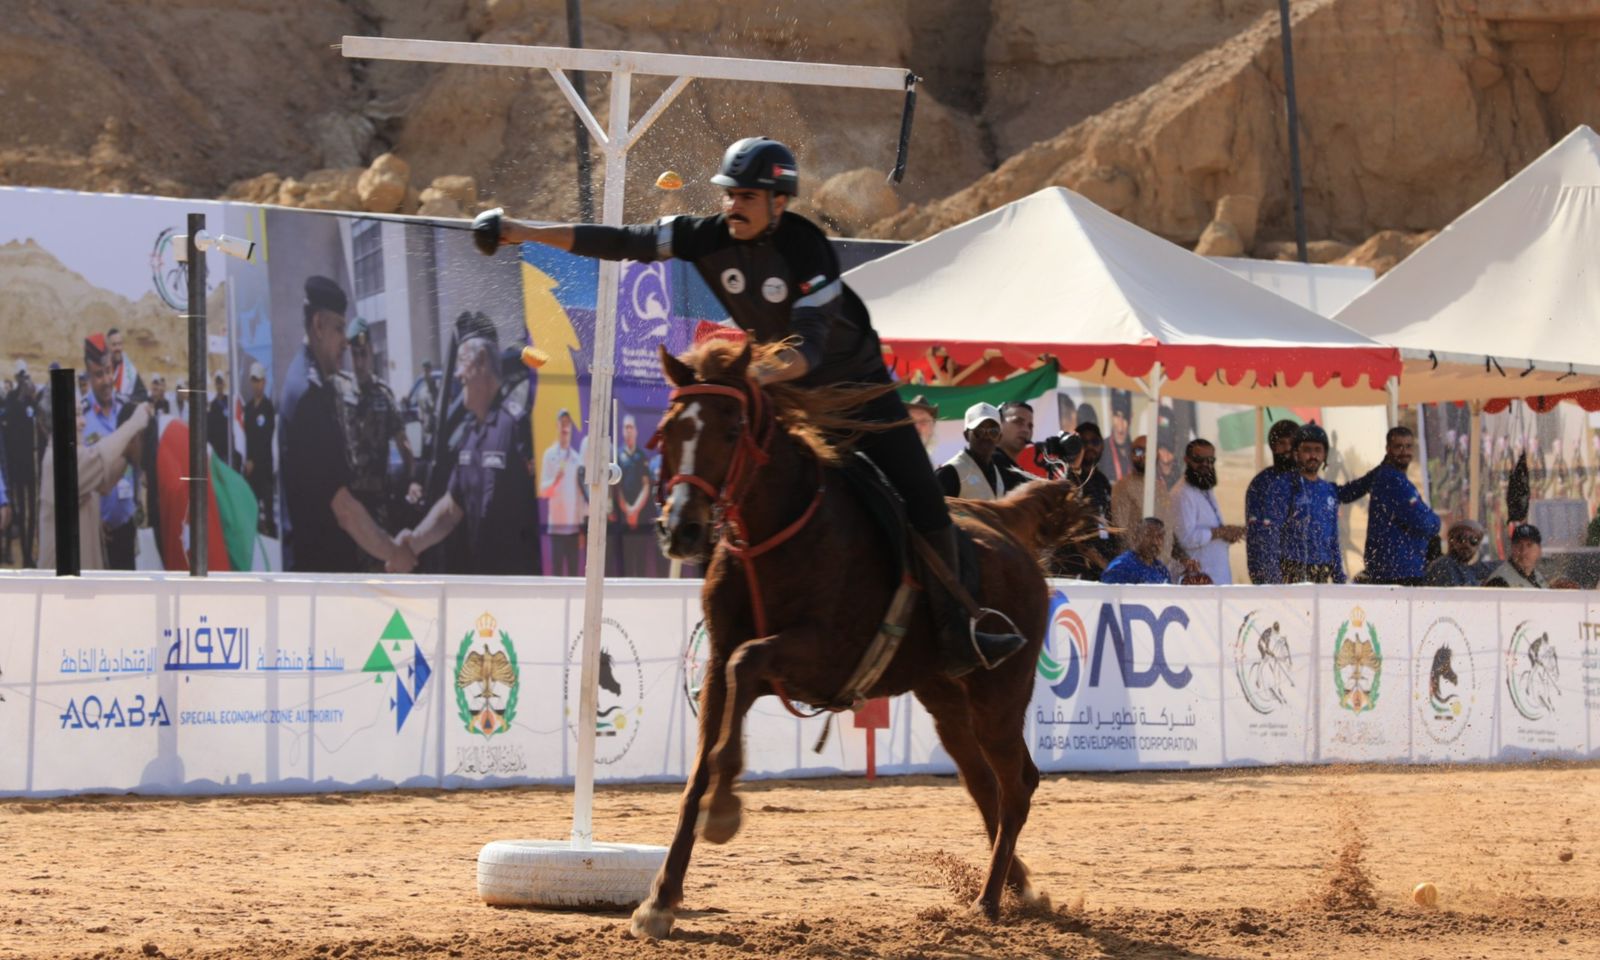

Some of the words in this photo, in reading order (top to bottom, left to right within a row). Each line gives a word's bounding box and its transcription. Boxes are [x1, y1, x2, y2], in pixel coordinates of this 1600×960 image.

[256, 646, 304, 671] منطقة
[1088, 602, 1193, 690] ADC
[60, 647, 96, 673] الخاصة
[59, 694, 171, 730] AQABA
[180, 711, 217, 725] SPECIAL
[220, 710, 268, 724] ECONOMIC
[269, 709, 293, 723] ZONE
[295, 708, 344, 723] AUTHORITY
[1036, 705, 1092, 729] العقبة
[1095, 706, 1137, 730] تطوير
[1139, 705, 1196, 731] شركة
[1038, 736, 1071, 750] AQABA
[1073, 736, 1137, 750] DEVELOPMENT
[1139, 736, 1198, 750] CORPORATION
